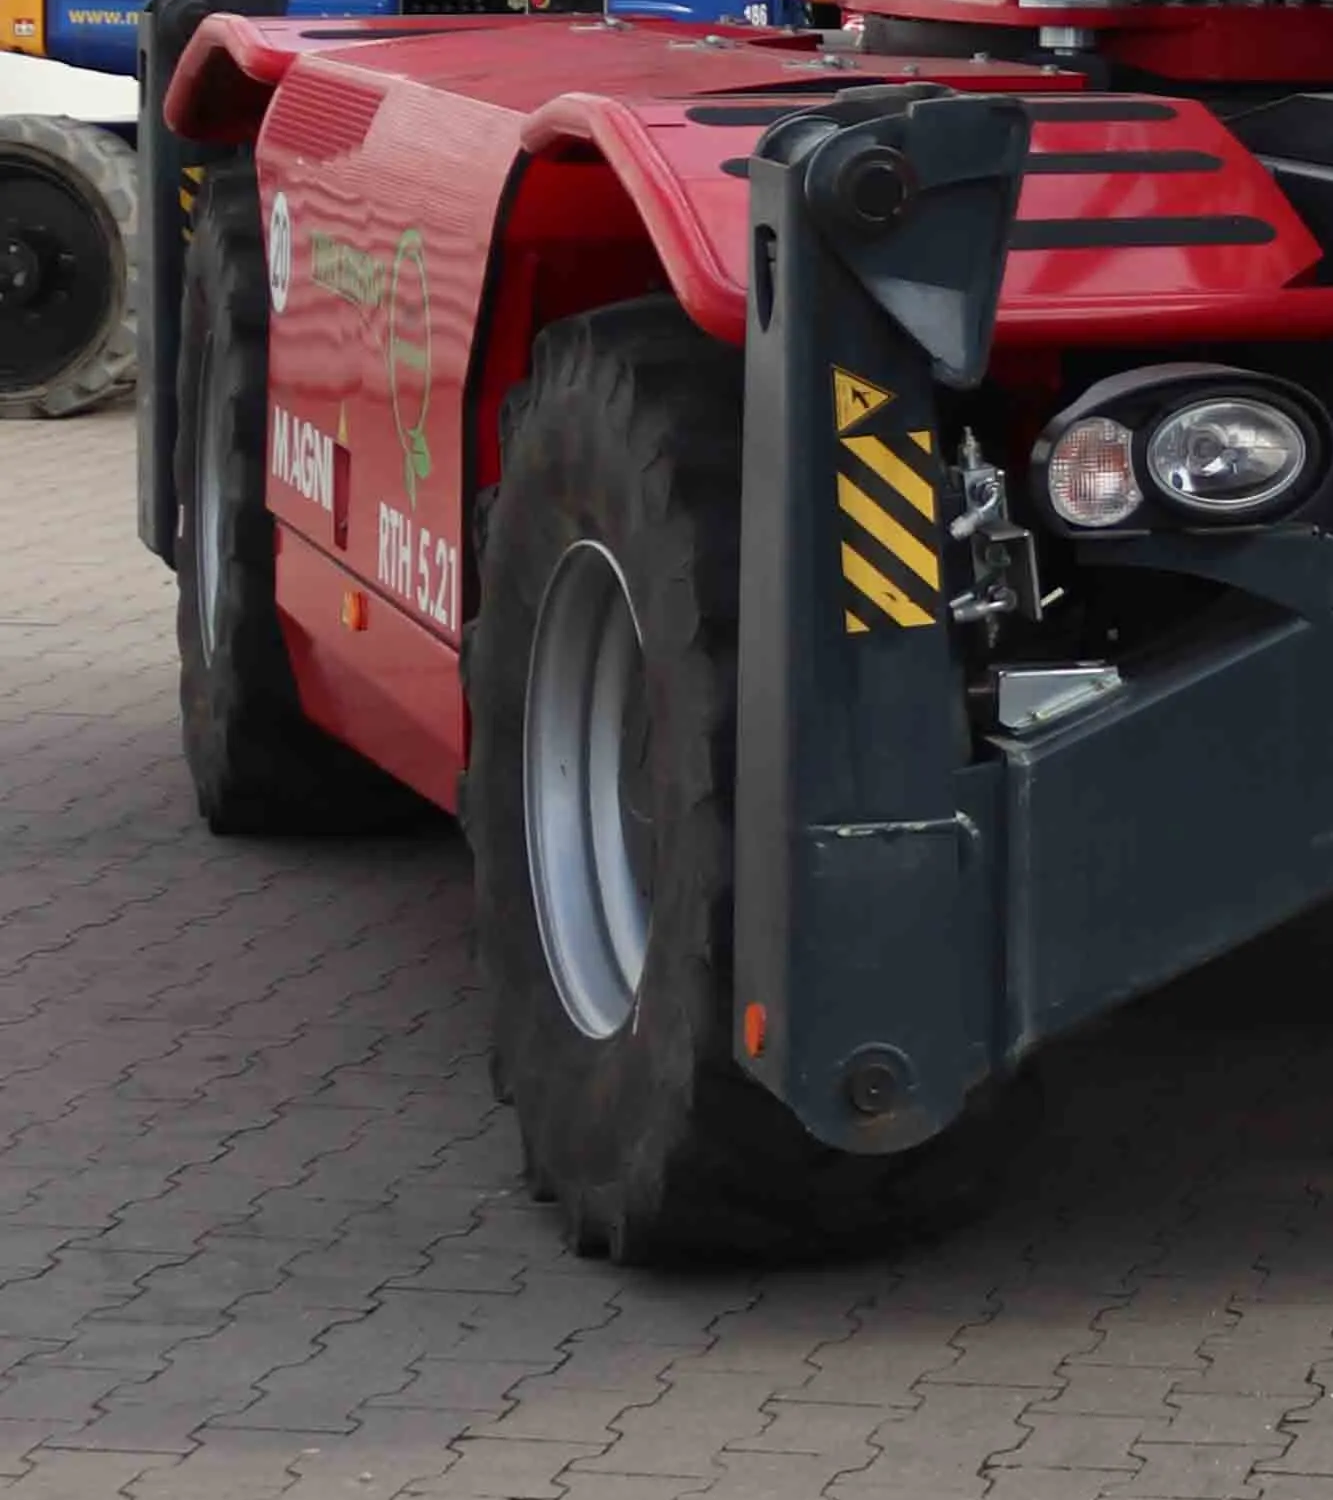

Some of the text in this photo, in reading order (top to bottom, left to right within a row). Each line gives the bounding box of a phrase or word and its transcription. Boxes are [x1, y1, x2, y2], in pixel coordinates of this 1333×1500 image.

[272, 405, 334, 512] MAGNI
[379, 501, 457, 633] RTH 5.21
